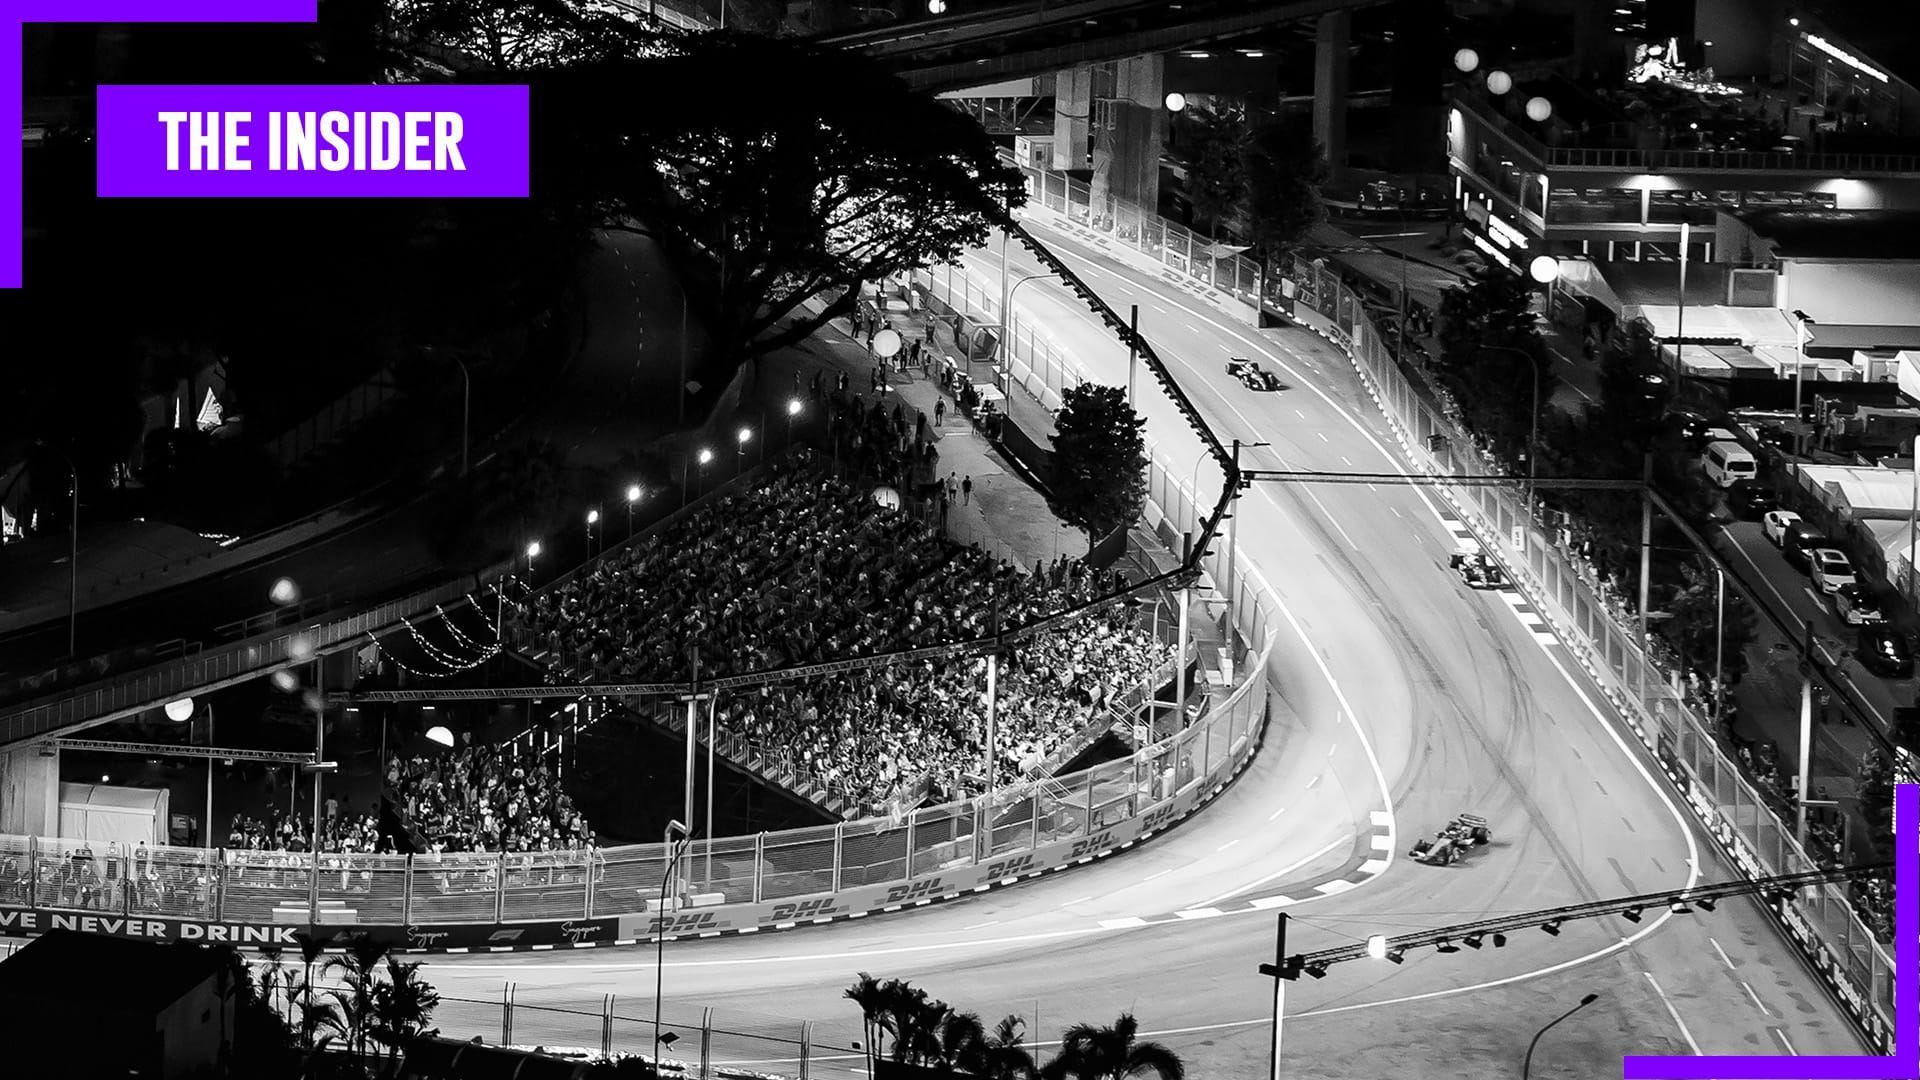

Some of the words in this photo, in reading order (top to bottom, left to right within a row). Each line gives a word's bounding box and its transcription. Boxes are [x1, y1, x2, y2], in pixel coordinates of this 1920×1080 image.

[1052, 217, 1112, 251] DHL
[1161, 267, 1221, 305] DHL
[1615, 686, 1646, 732] DHL
[1070, 831, 1113, 858] DHL
[987, 854, 1034, 880] DHL
[886, 877, 944, 903] DHL
[648, 912, 718, 934] DHL
[771, 898, 838, 921] DHL
[0, 911, 37, 928] VE
[52, 913, 167, 938] NEVER
[180, 922, 300, 943] DRINK
